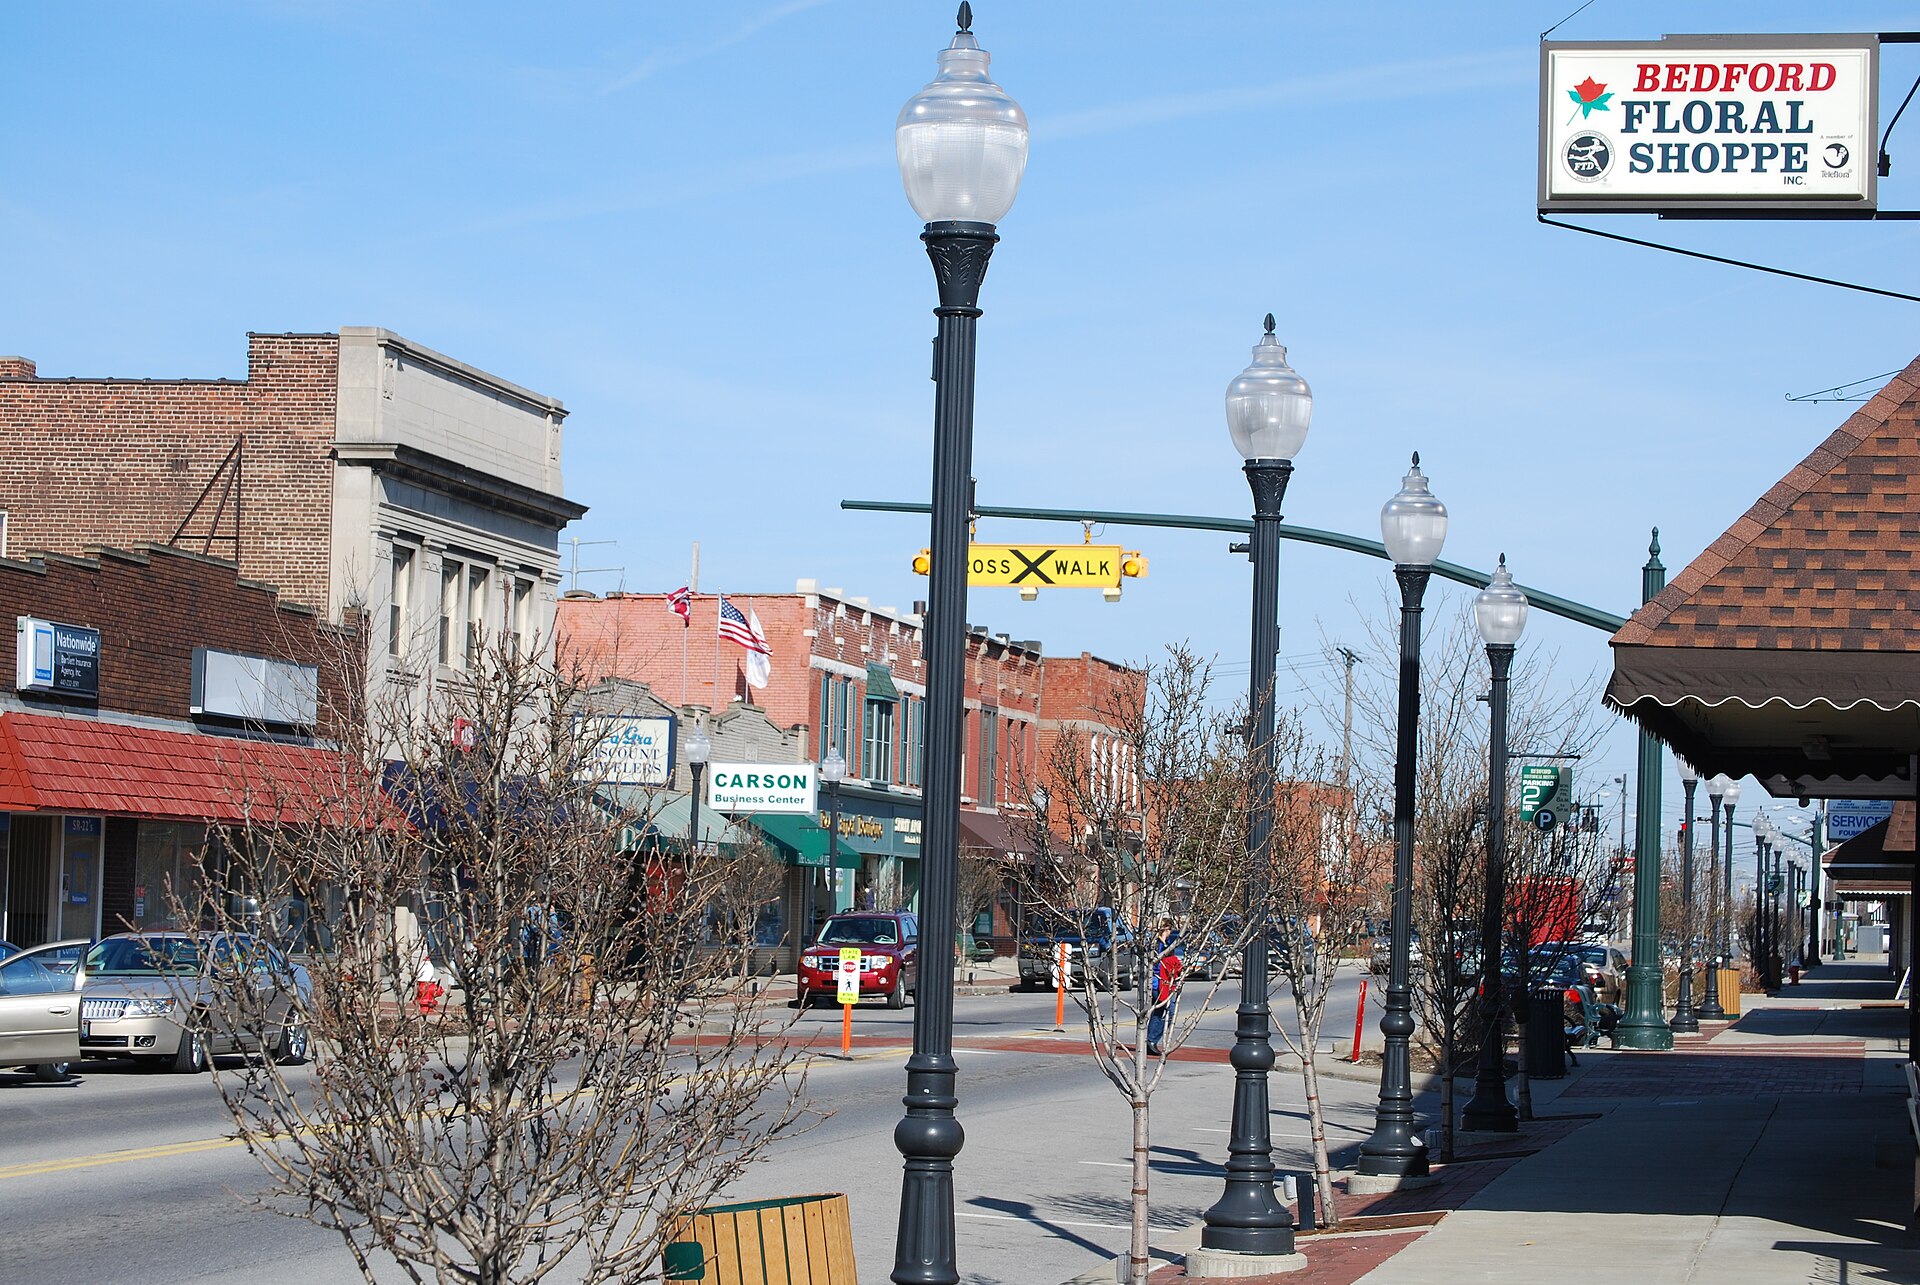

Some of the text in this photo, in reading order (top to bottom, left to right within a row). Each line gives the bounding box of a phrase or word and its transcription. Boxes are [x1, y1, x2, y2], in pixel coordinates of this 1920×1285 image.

[1632, 62, 1837, 92] BEDFORD
[1620, 100, 1814, 134] FLORAL
[1628, 142, 1808, 173] SHOPPE
[1573, 162, 1595, 171] FTD
[1783, 175, 1807, 186] INC.
[1055, 560, 1110, 576] WALK
[56, 631, 96, 652] Nationwide
[594, 747, 660, 760] ISCOUNT
[714, 773, 807, 789] CARSON
[715, 794, 805, 804] Business Center
[1523, 786, 1540, 805] 2
[1539, 812, 1552, 828] P
